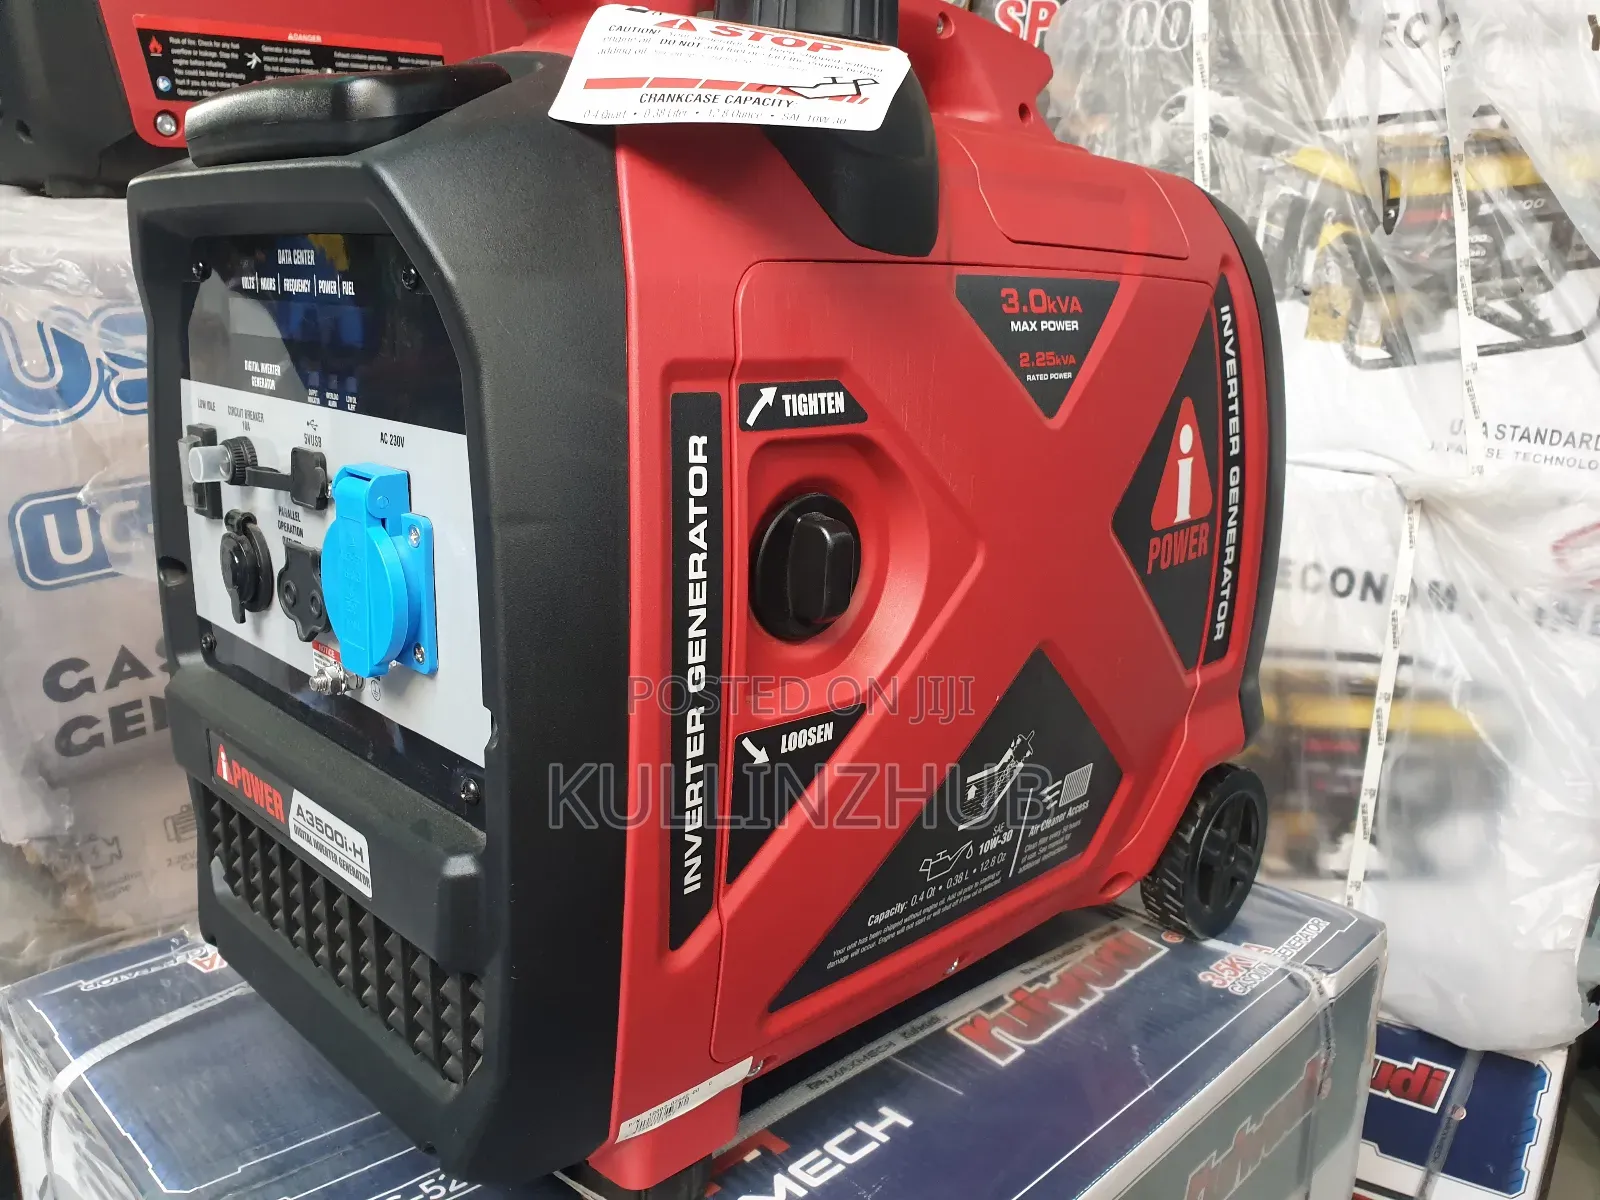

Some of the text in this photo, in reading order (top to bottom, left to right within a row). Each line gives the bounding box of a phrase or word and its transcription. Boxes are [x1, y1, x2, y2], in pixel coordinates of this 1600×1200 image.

[679, 40, 701, 48] NOT
[710, 25, 844, 53] STOP
[640, 92, 721, 104] CRANKCASE
[277, 249, 316, 266] DATA CENTER
[241, 276, 356, 296] VOLTS HOURS FREQUENCY POWER FUEL
[1000, 286, 1083, 315] 3.0kVA
[1010, 319, 1079, 333] MAX POWER
[1018, 352, 1077, 368] 2.25kVA
[1026, 371, 1073, 382] RATED POWER
[197, 398, 216, 412] LOW IDLE
[227, 405, 265, 424] CIRCUIT BREAKER
[781, 391, 845, 418] TIGHTEN
[379, 431, 405, 448] AC 230V
[1213, 304, 1240, 642] INVERTER GENERATOR
[278, 505, 301, 523] PARALLEL
[277, 519, 304, 539] OPERATION
[1146, 521, 1210, 575] POWER
[686, 434, 709, 693] GENERATOR
[780, 721, 835, 755] LOOSEN
[231, 759, 286, 825] POWER
[683, 705, 705, 896] INVERTER
[993, 821, 1006, 837] SAE
[1028, 799, 1090, 838] Air Cleaner Access
[296, 803, 365, 864] A3500i-H
[979, 829, 1014, 856] 10W-30
[293, 823, 371, 890] DIGITAL INVERTER GENERATOR
[867, 852, 1007, 927] Capacity: 0.4 Qt 0.38 L 12.8 Oz
[857, 936, 869, 946] has
[868, 929, 883, 941] been
[882, 918, 904, 934] shipped
[826, 954, 850, 970] damage
[878, 931, 896, 945] Engine
